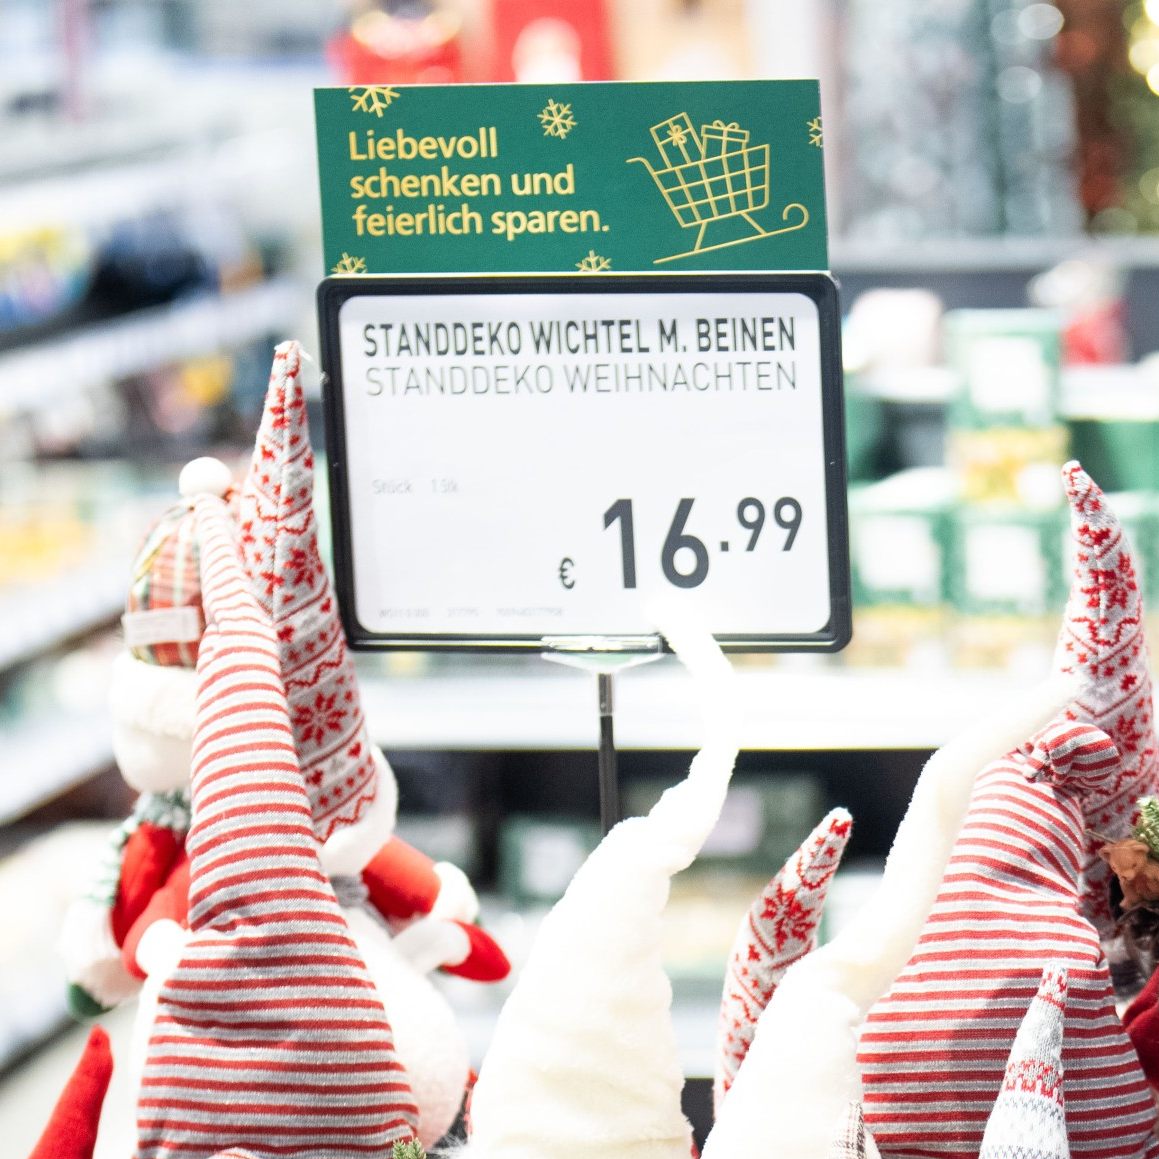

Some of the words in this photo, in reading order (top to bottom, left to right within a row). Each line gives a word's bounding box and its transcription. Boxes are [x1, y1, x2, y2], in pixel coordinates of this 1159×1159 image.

[349, 126, 498, 161] Liebevoll
[350, 166, 502, 199] schenken
[510, 163, 576, 196] und
[352, 202, 484, 237] feierlich
[490, 209, 611, 242] sparen.
[362, 321, 522, 358] STANDDEKO
[529, 319, 650, 355] WICHTEL
[657, 318, 687, 353] M.
[696, 316, 797, 352] BEINEN
[366, 364, 554, 397] STANDDEKO
[563, 360, 798, 393] WEIHNACHTEN
[558, 556, 577, 590] €
[602, 496, 803, 590] 16.99
